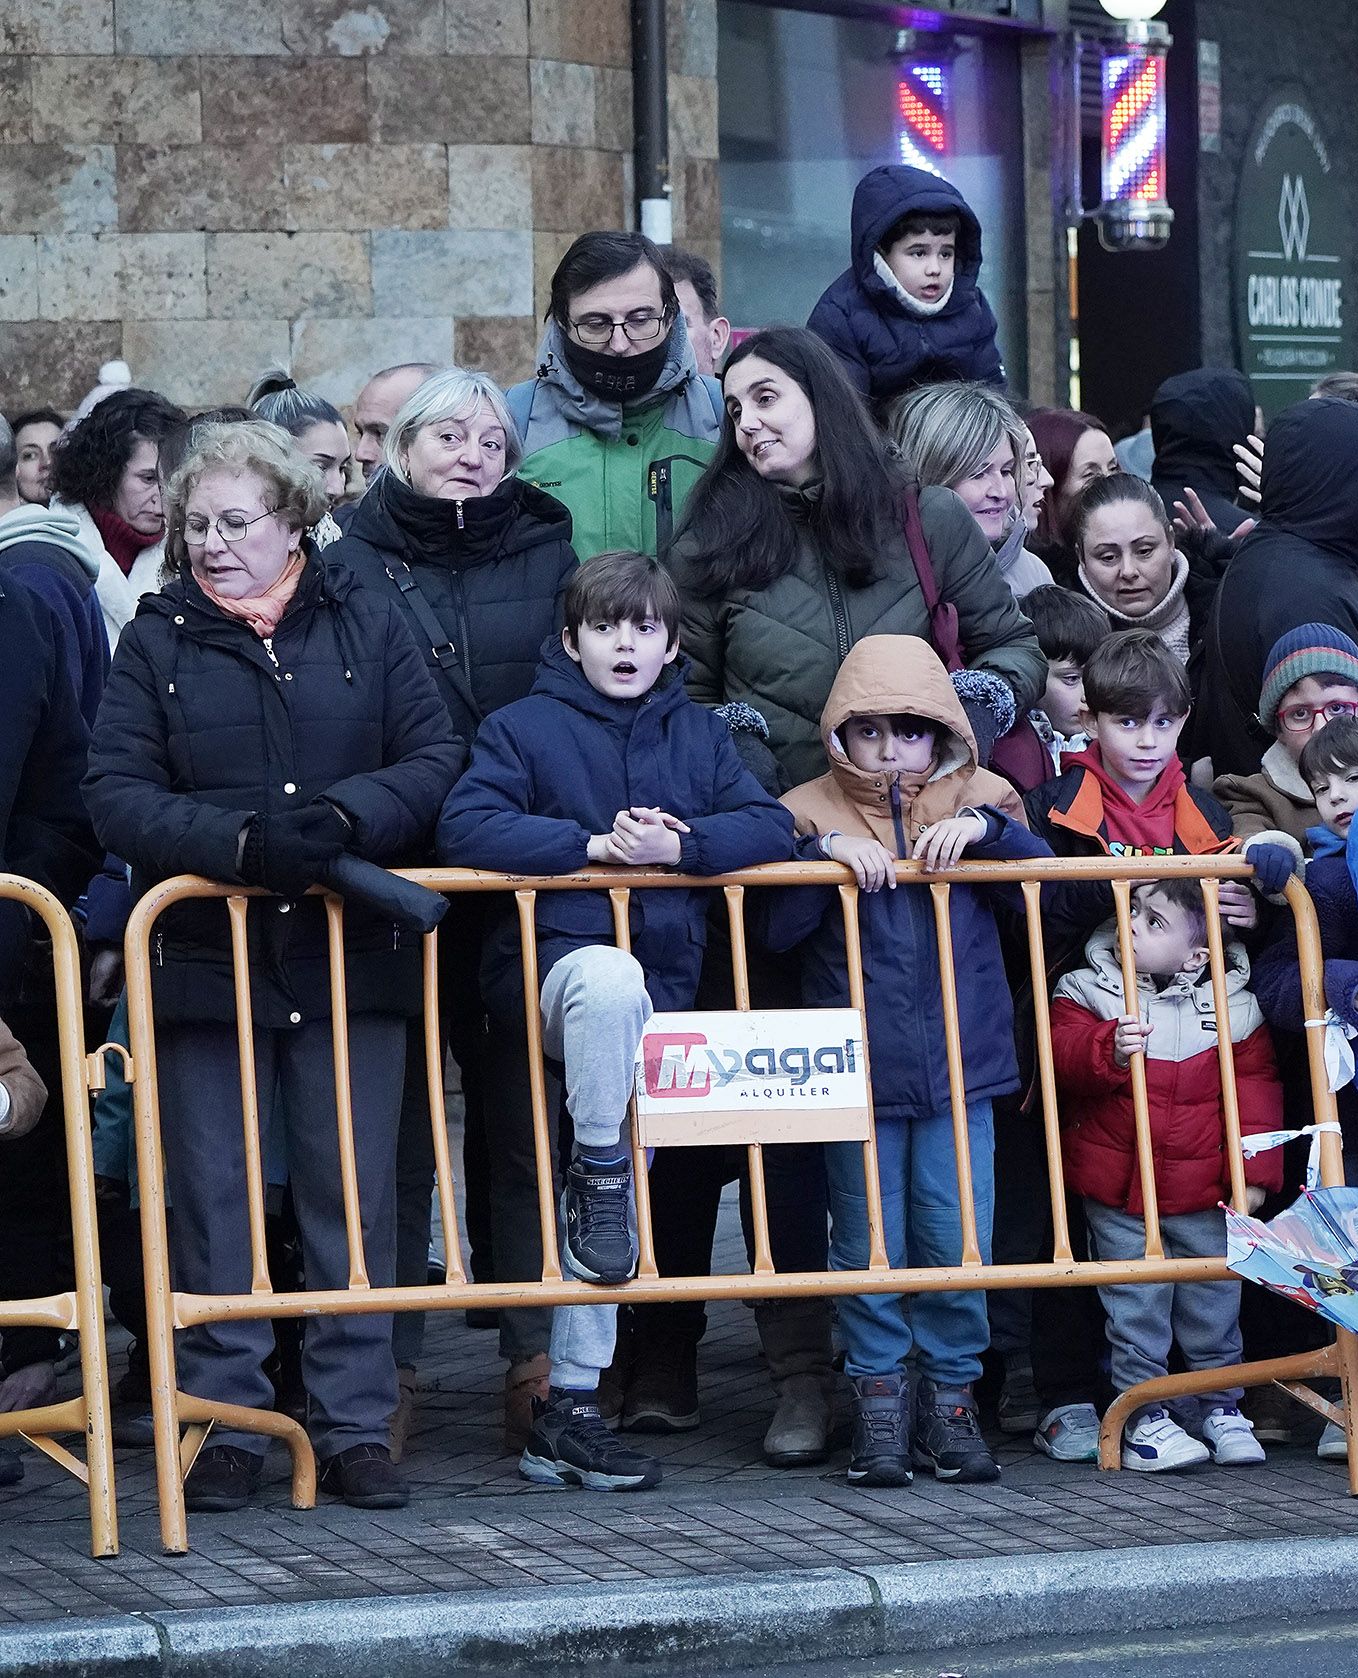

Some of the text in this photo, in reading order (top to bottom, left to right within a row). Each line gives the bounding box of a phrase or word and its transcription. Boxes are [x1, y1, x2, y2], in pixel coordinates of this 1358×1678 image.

[1247, 275, 1299, 327] CARLOS
[1300, 277, 1342, 328] CONDE
[740, 1087, 831, 1099] ALQUILER
